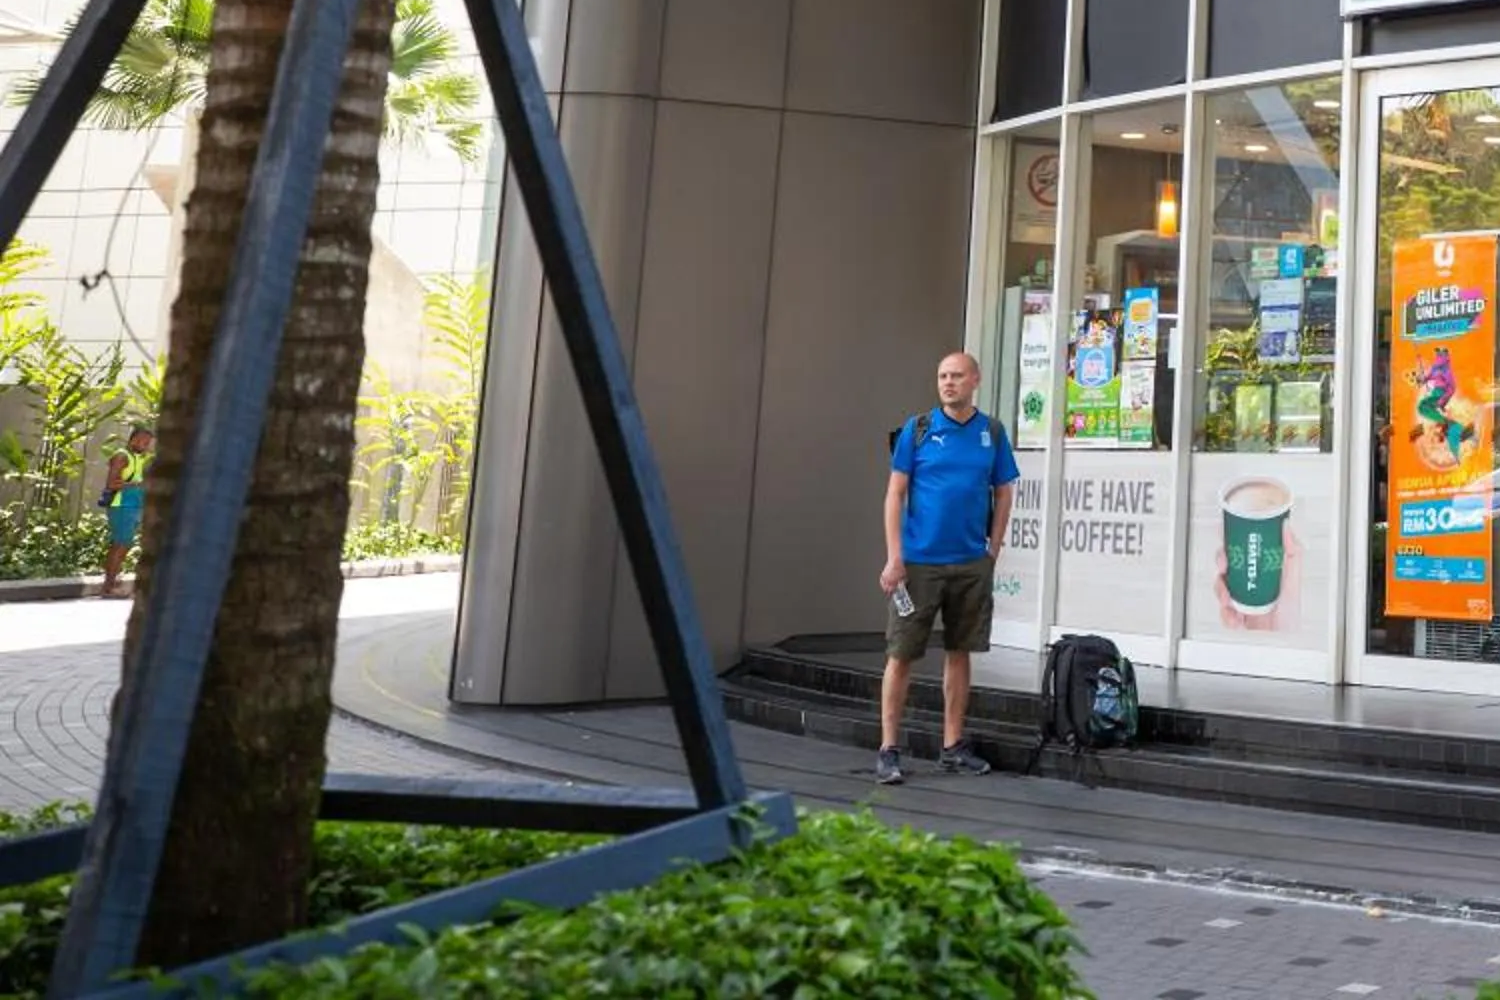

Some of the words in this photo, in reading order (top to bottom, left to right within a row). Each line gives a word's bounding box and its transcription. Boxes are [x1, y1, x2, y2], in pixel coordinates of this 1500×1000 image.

[1415, 298, 1486, 320] UNLIMITED
[1416, 284, 1460, 306] GILER
[1015, 479, 1042, 511] HIN
[1064, 479, 1094, 512] WE
[1101, 480, 1155, 514] HAVE
[1011, 518, 1042, 550] BES
[1061, 519, 1144, 556] COFFEE!
